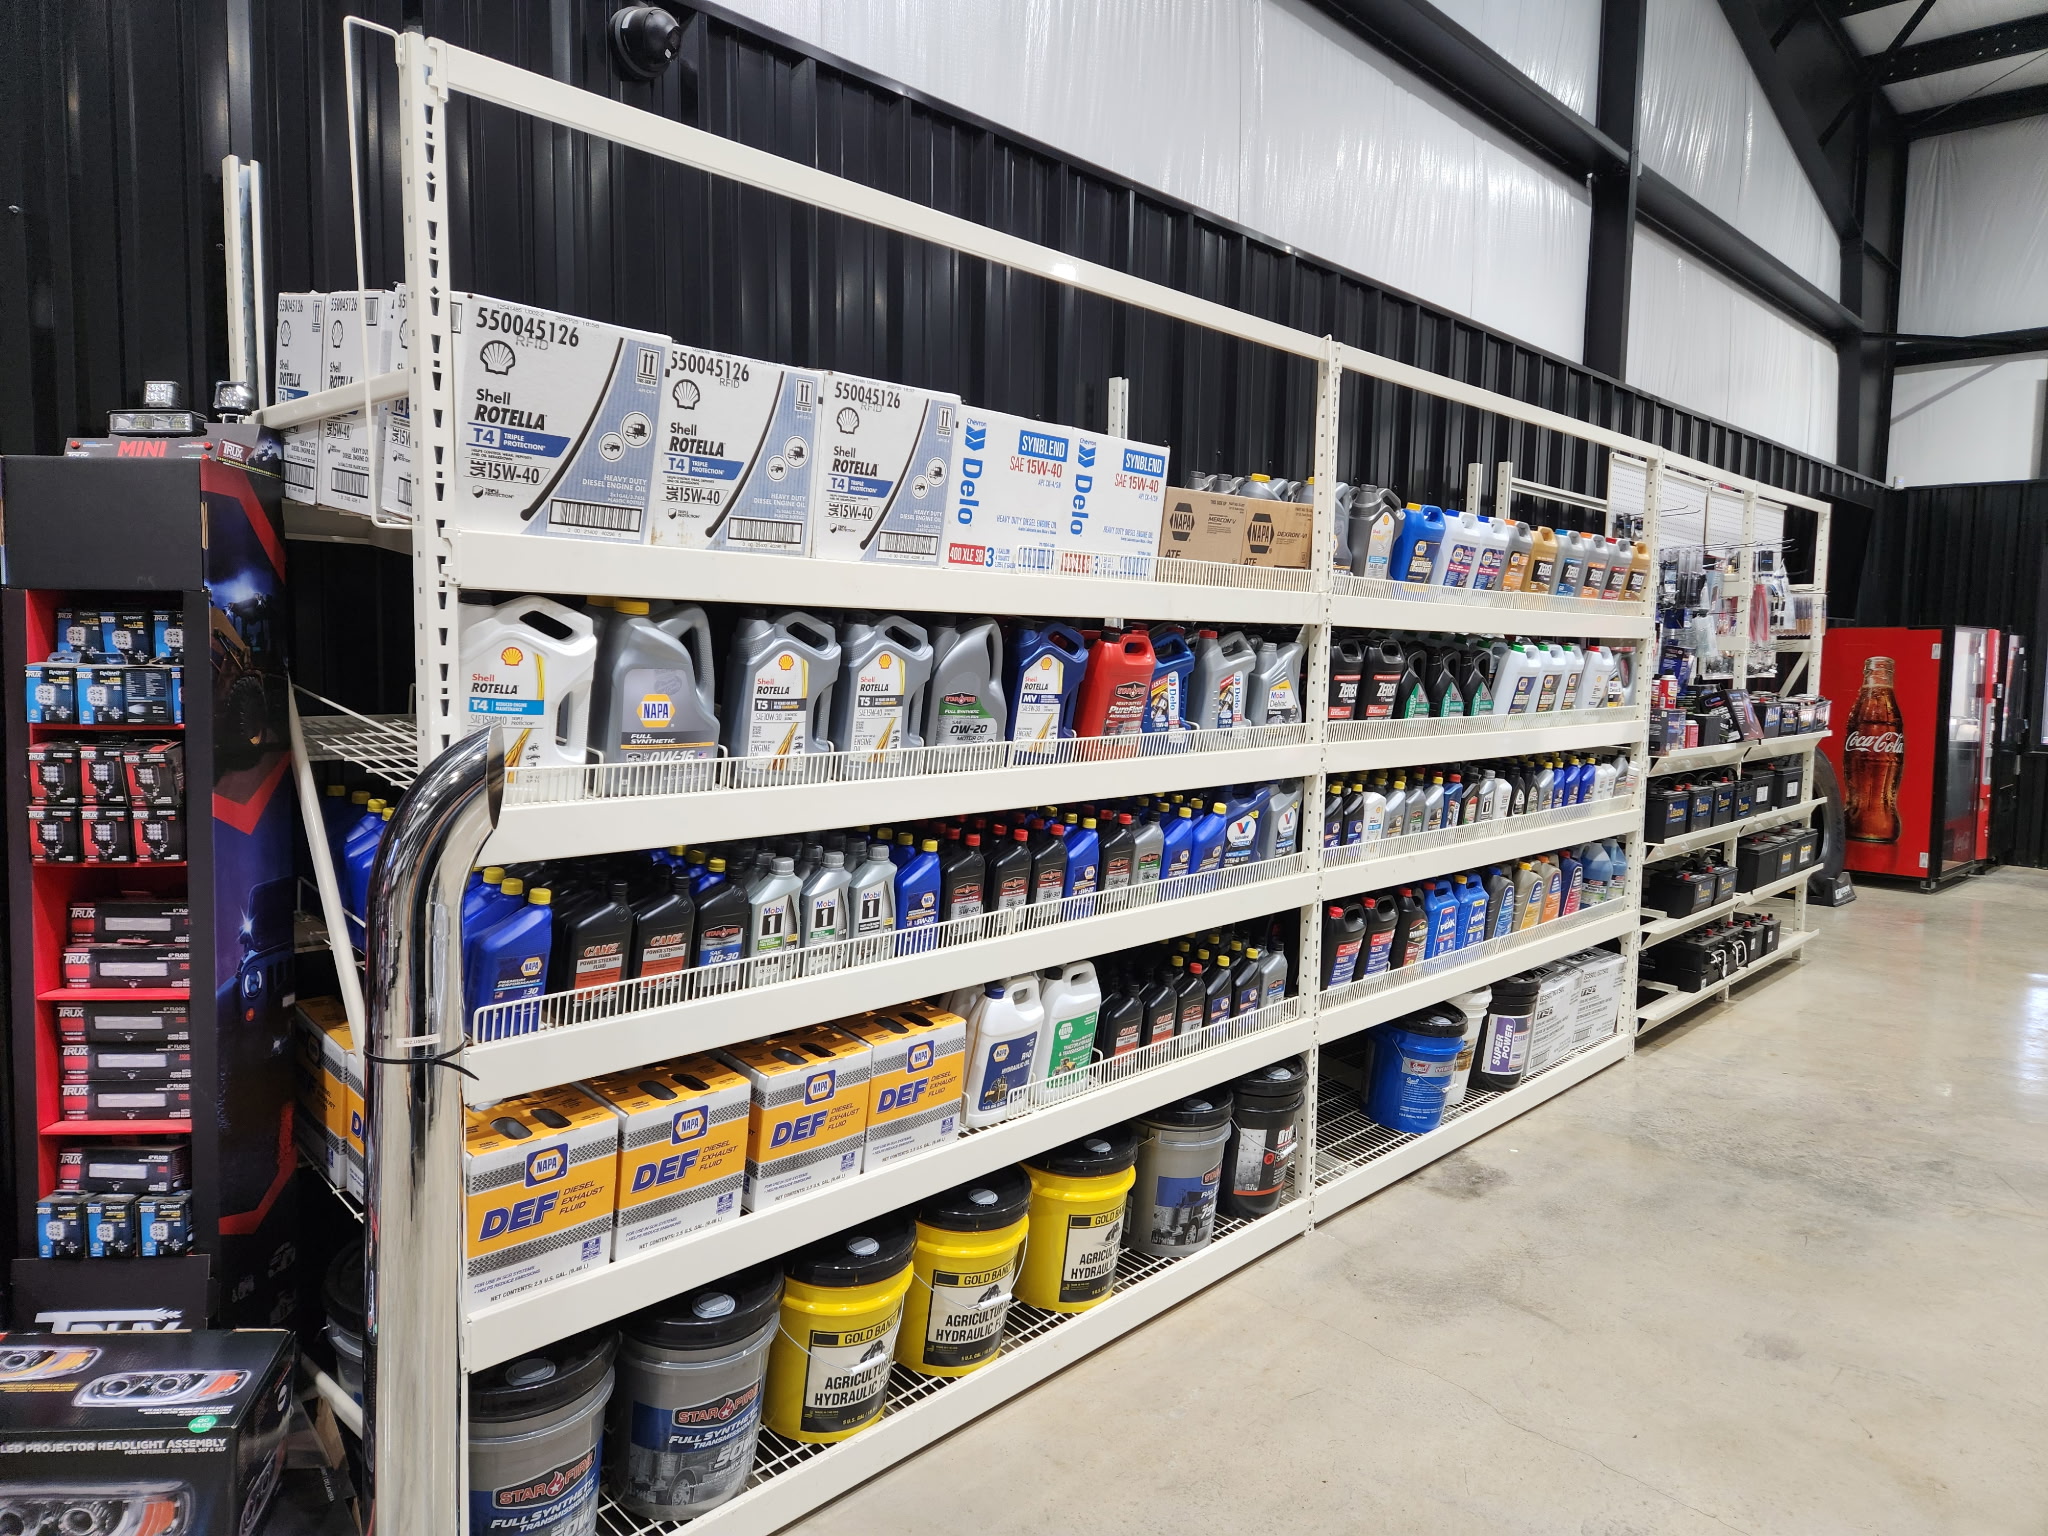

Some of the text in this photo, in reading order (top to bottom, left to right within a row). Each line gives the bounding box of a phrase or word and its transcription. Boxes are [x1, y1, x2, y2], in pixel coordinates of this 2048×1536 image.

[476, 306, 579, 347] 550045126
[516, 335, 548, 350] RFID
[279, 360, 289, 370] Shell
[330, 362, 341, 373] Shell
[671, 351, 749, 382] 550045126
[279, 373, 301, 388] ROTELLA
[719, 377, 740, 388] RFID
[476, 388, 510, 405] Shell
[835, 382, 900, 409] 550045126
[474, 404, 545, 430] ROTELLA
[967, 417, 987, 427] Chevron
[473, 428, 495, 444] T4
[670, 422, 697, 436] Shell
[504, 433, 524, 442] TRIPLE
[118, 440, 167, 457] MINI
[222, 440, 243, 459] TRUX
[669, 436, 724, 457] ROTELLA
[834, 446, 856, 459] Shell
[1021, 436, 1065, 458] SYNBLEND
[669, 457, 685, 471] T4
[832, 458, 878, 477] ROTELLA
[1010, 456, 1062, 478] SAE 15W-40
[1126, 453, 1162, 473] SYNBLEND
[470, 460, 539, 484] SAE 15W-40
[582, 478, 646, 492] DIESEL ENGINE OIL
[604, 474, 647, 486] HEAVY DUTY
[832, 477, 845, 490] T4
[1115, 473, 1158, 493] SAE 15W-40
[666, 486, 720, 504] SAE 15W-40
[958, 457, 983, 525] Delo
[754, 497, 772, 505] DIESEL
[773, 499, 795, 507] ENGINE
[1070, 474, 1093, 535] Delo
[828, 503, 873, 520] SAE 15W-40
[997, 515, 1036, 526] HEAVY DUTY DIESEL
[1173, 513, 1190, 530] NAPA
[1251, 525, 1269, 543] NAPA
[950, 547, 974, 561] 400 XLE
[985, 547, 995, 567] 3
[472, 674, 494, 682] Shell
[471, 683, 518, 694] ROTELLA
[756, 686, 790, 695] ROTELLA
[860, 684, 889, 692] ROTELLA
[1270, 691, 1285, 699] Mobil
[472, 700, 488, 711] T4
[757, 700, 768, 709] T5
[860, 697, 870, 706] T5
[644, 704, 668, 718] NAPA
[950, 725, 987, 734] 0W-20
[1845, 731, 1904, 753] Coca-Cola
[80, 751, 97, 759] TRUX
[123, 755, 140, 763] TRUX
[650, 750, 695, 762] 0W-16
[81, 811, 98, 819] TRUX
[132, 811, 149, 819] TRUX
[863, 891, 881, 900] Mobil
[764, 905, 784, 915] Mobil
[816, 899, 836, 908] Mobil
[69, 908, 96, 918] TRUX
[1470, 912, 1485, 924] PEAK
[1440, 919, 1455, 933] PEAK
[651, 933, 683, 946] CAM2
[584, 943, 618, 957] CAM2
[663, 944, 685, 952] STEERING
[64, 953, 91, 964] TRUX
[599, 956, 620, 964] STEERING
[709, 952, 739, 963] ND-30
[524, 962, 539, 972] NAPA
[497, 979, 541, 987] PERFORMANCE
[57, 1007, 84, 1017] TRUX
[1502, 1024, 1514, 1059] POWER
[61, 1045, 89, 1056] TRUX
[914, 1051, 927, 1062] NAPA
[1492, 1033, 1503, 1066] SUPER
[930, 1076, 957, 1089] EXHAUST
[931, 1071, 951, 1081] DIESEL
[61, 1084, 89, 1095] TRUX
[813, 1080, 828, 1094] NAPA
[928, 1087, 946, 1097] FLUID
[876, 1077, 930, 1114] DEF
[829, 1108, 860, 1122] EXHAUST
[831, 1102, 854, 1114] DIESEL
[681, 1117, 699, 1131] NAPA
[769, 1109, 829, 1149] DEF
[827, 1120, 847, 1131] FLUID
[701, 1145, 738, 1162] EXHAUST
[703, 1140, 731, 1153] DIESEL
[60, 1153, 82, 1164] TRUX
[536, 1156, 557, 1174] NAPA
[699, 1159, 722, 1171] FLUID
[630, 1148, 702, 1194] DEF
[563, 1180, 596, 1195] DIESEL
[561, 1185, 605, 1205] EXHAUST
[559, 1201, 586, 1215] FLUID
[478, 1190, 561, 1243] DEF
[1095, 1212, 1114, 1225] GOLD
[964, 1272, 991, 1285] GOLD
[490, 1283, 534, 1302] NET CONTENTS:
[845, 1329, 873, 1345] GOLD
[936, 1323, 993, 1342] HYDRAULIC
[815, 1381, 878, 1405] HYDRAULIC
[679, 1383, 759, 1423] STAR FIRE
[26, 1438, 226, 1453] PROJECTOR HEADLIGHT ASSEMBLY
[669, 1435, 701, 1444] FULL
[500, 1452, 594, 1504] STAR FIRE
[490, 1516, 529, 1529] FULL
